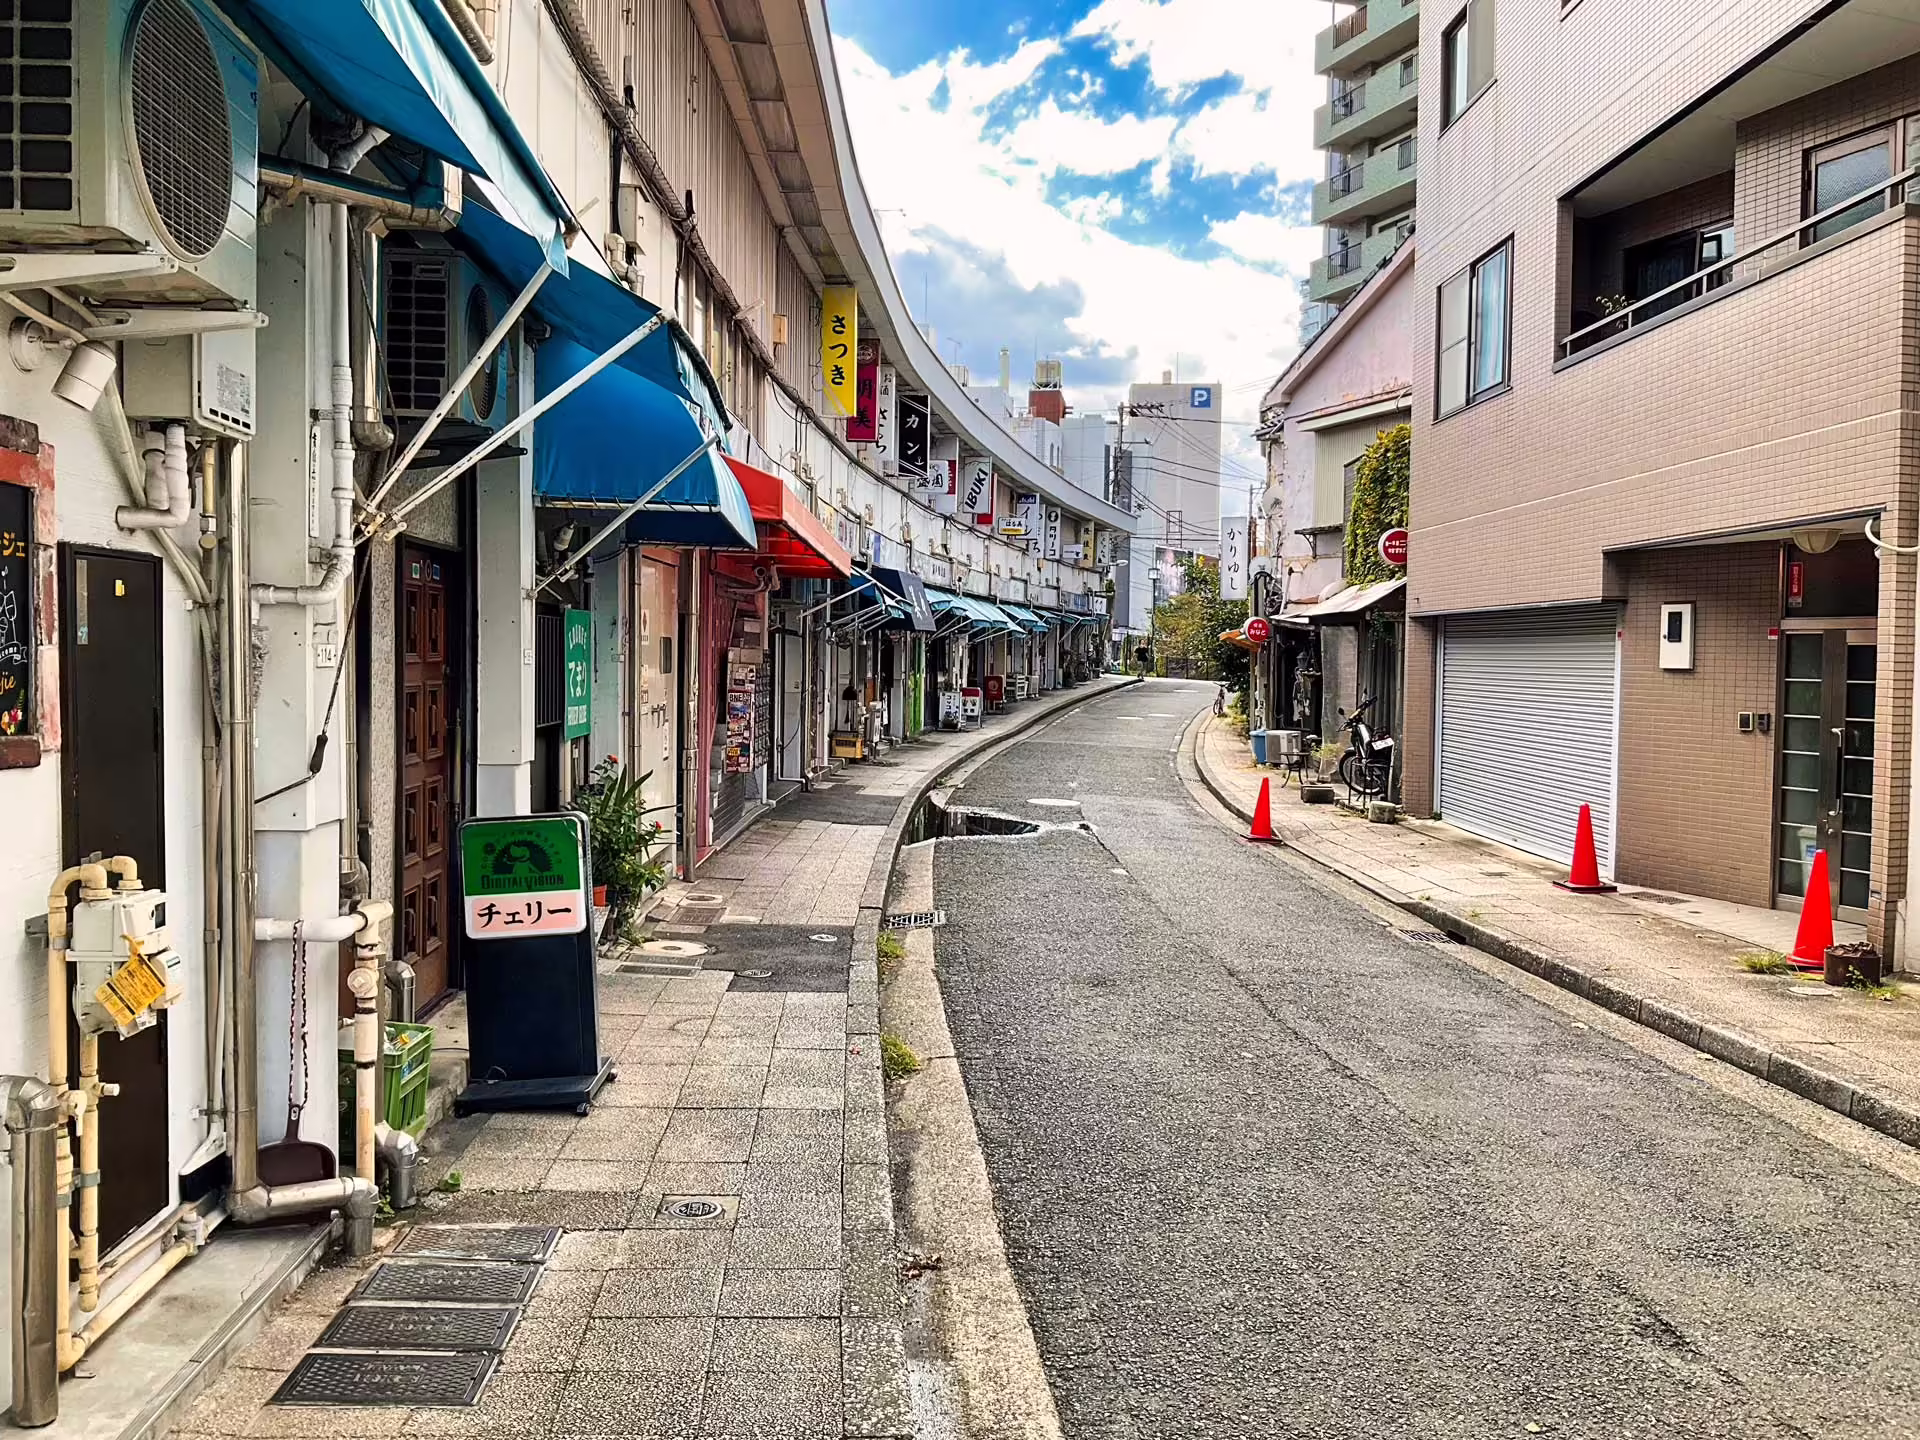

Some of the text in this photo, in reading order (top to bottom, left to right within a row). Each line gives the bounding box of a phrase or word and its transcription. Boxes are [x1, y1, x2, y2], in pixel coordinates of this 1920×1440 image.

[829, 315, 848, 386] さつき
[1194, 390, 1208, 406] P
[905, 414, 920, 455] カン
[965, 468, 989, 510] IBUKI
[0, 531, 25, 556] ジェ
[1227, 528, 1242, 591] かりゆし
[1250, 628, 1266, 636] みなと
[568, 661, 587, 697] てまり
[477, 901, 572, 928] チェリー
